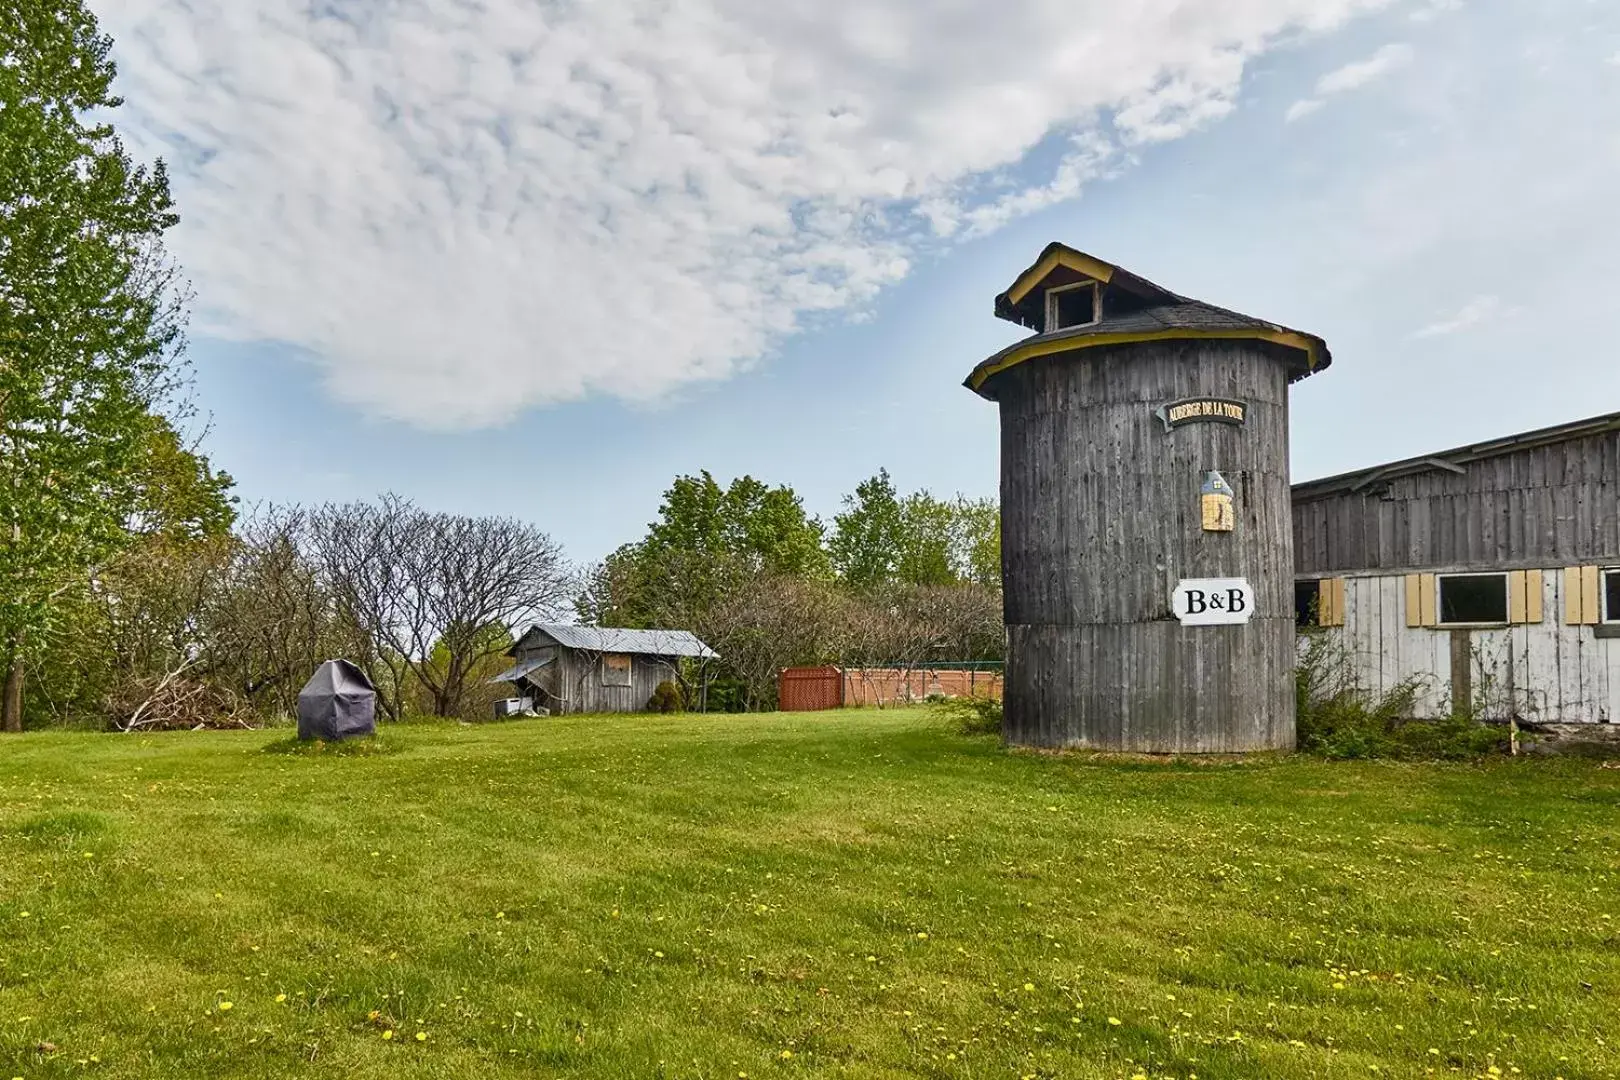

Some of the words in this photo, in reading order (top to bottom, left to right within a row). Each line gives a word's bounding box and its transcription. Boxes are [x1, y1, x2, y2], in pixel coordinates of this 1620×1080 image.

[1169, 402, 1201, 421] AUBERGE
[1202, 402, 1213, 416] DE
[1213, 402, 1223, 416] LA
[1223, 403, 1243, 420] TOUR
[1184, 588, 1245, 614] B&B
